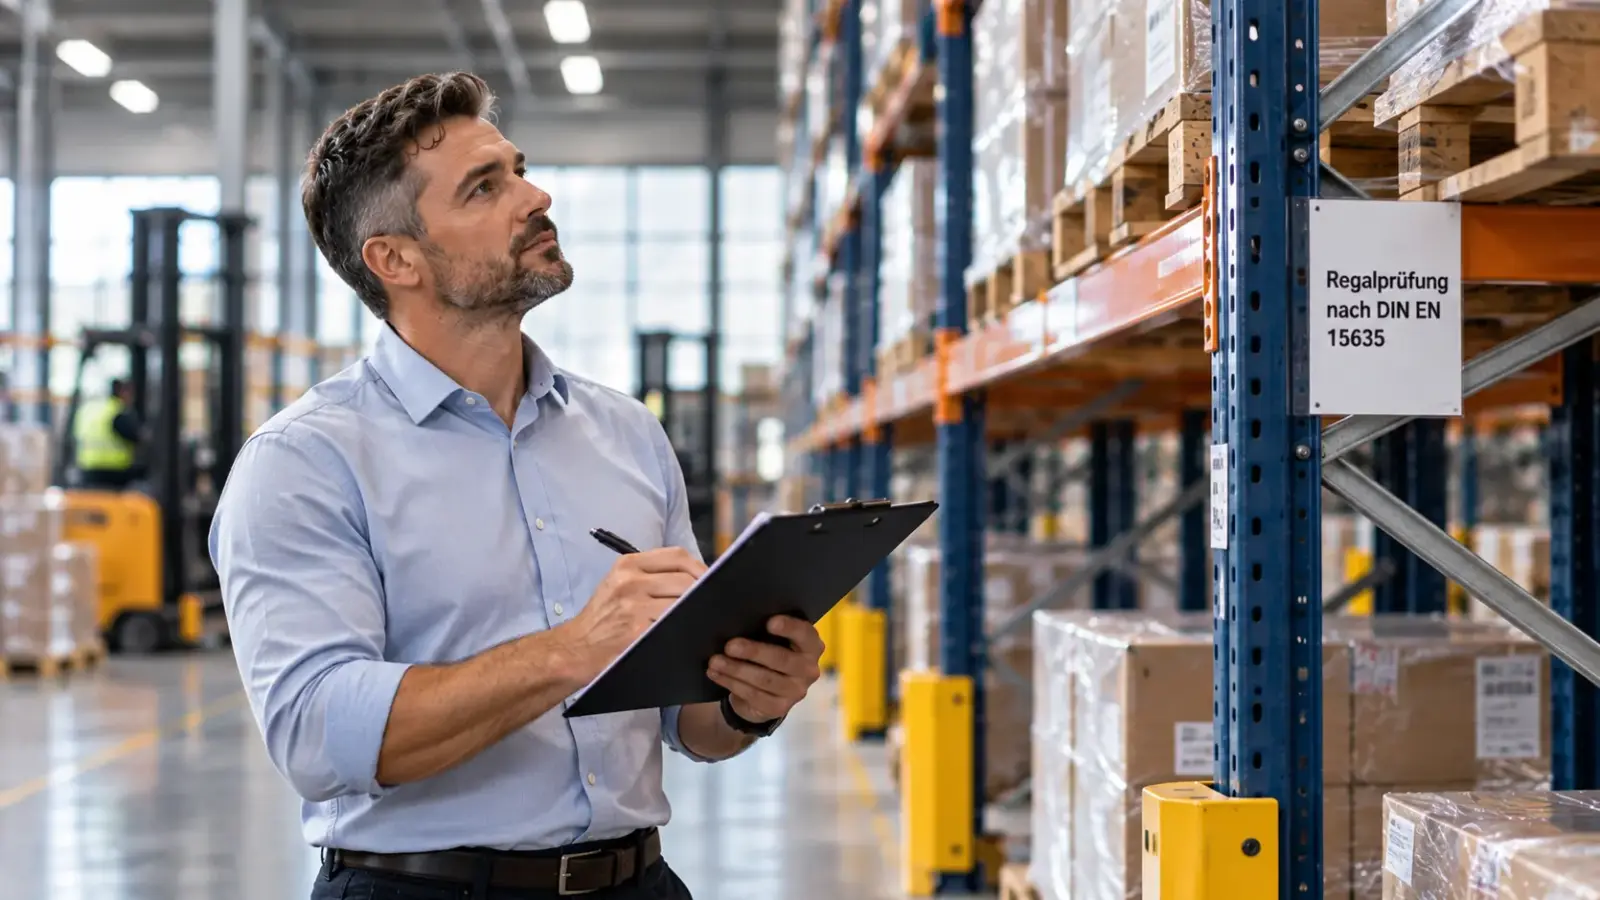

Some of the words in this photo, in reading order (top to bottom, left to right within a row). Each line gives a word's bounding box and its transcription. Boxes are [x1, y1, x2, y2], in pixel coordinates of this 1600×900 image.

[1326, 270, 1449, 294] Regalprüfung
[1326, 300, 1371, 319] nach
[1376, 301, 1410, 319] DIN
[1415, 301, 1441, 319] EN
[1327, 328, 1386, 347] 15635
